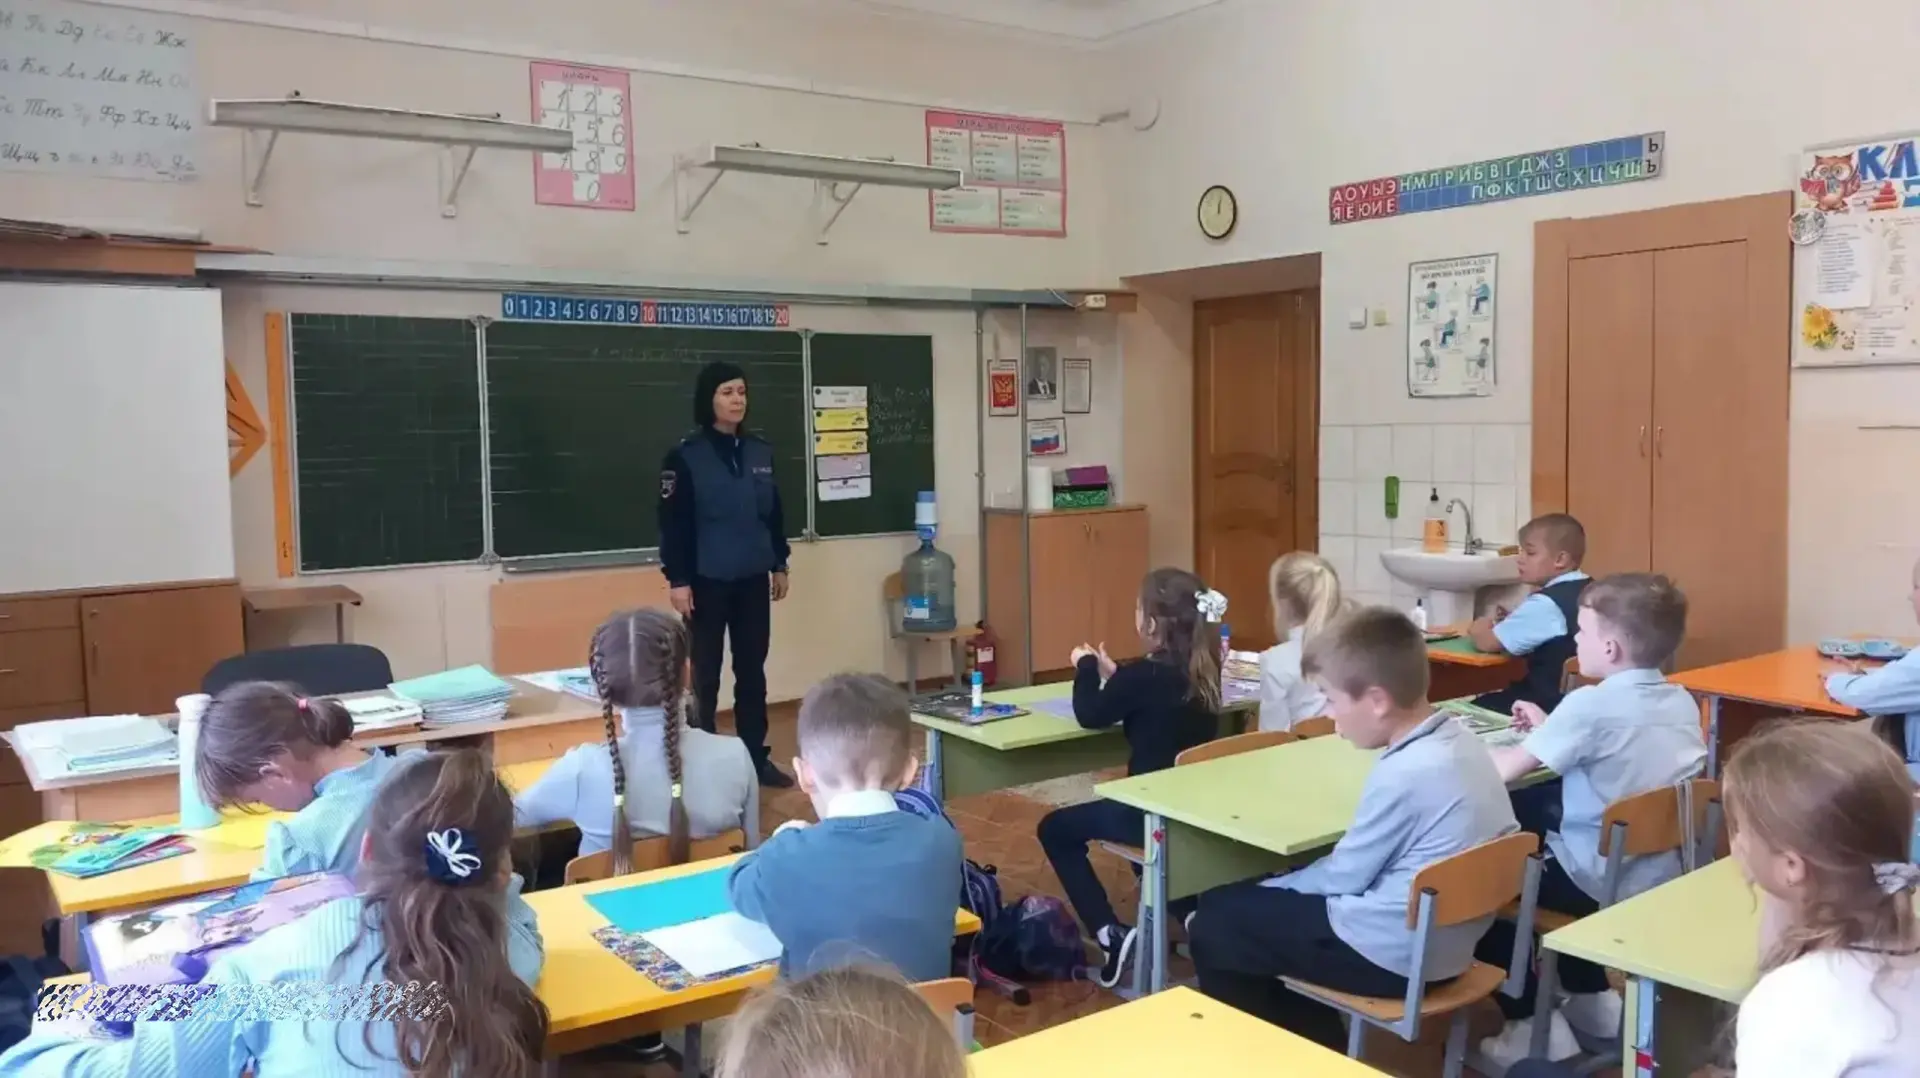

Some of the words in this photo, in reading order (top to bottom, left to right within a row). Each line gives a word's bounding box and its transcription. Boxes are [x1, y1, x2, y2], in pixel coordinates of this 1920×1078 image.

[505, 298, 513, 315] 0
[520, 300, 527, 315] 1
[534, 300, 542, 316] 2
[549, 301, 556, 317] 3
[563, 302, 571, 319] 4
[577, 303, 584, 319] 5
[590, 304, 598, 319] 6
[604, 304, 612, 320] 7
[617, 305, 624, 320] 8
[630, 305, 638, 320] 9
[643, 306, 654, 323] 10
[658, 306, 666, 323] 11
[671, 306, 682, 322] 12
[685, 306, 695, 323] 13
[699, 307, 710, 323] 14
[712, 308, 723, 323] 15
[765, 308, 774, 323] 19
[776, 309, 787, 324] 20
